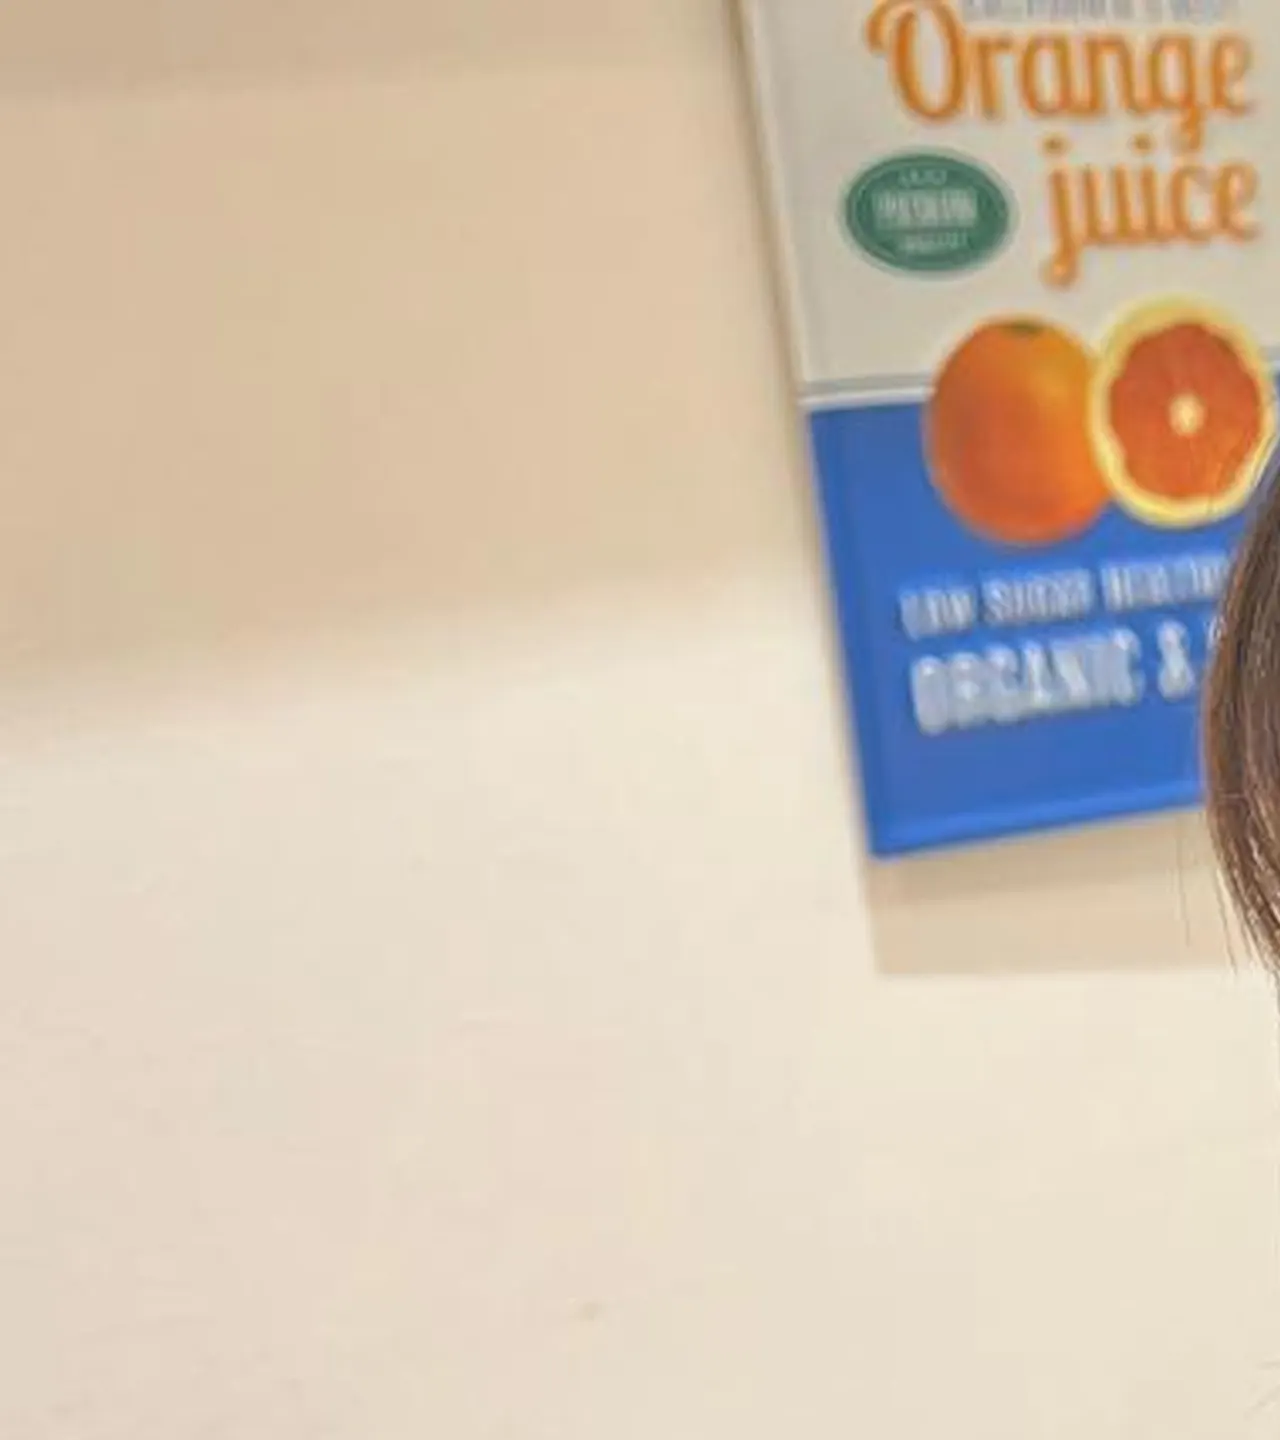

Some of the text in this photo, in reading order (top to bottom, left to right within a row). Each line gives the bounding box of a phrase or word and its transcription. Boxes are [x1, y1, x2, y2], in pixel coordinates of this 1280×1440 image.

[865, 0, 1259, 154] Orange
[1042, 134, 1258, 288] juice
[911, 627, 1145, 735] ORGANIC
[1156, 620, 1194, 698] &
